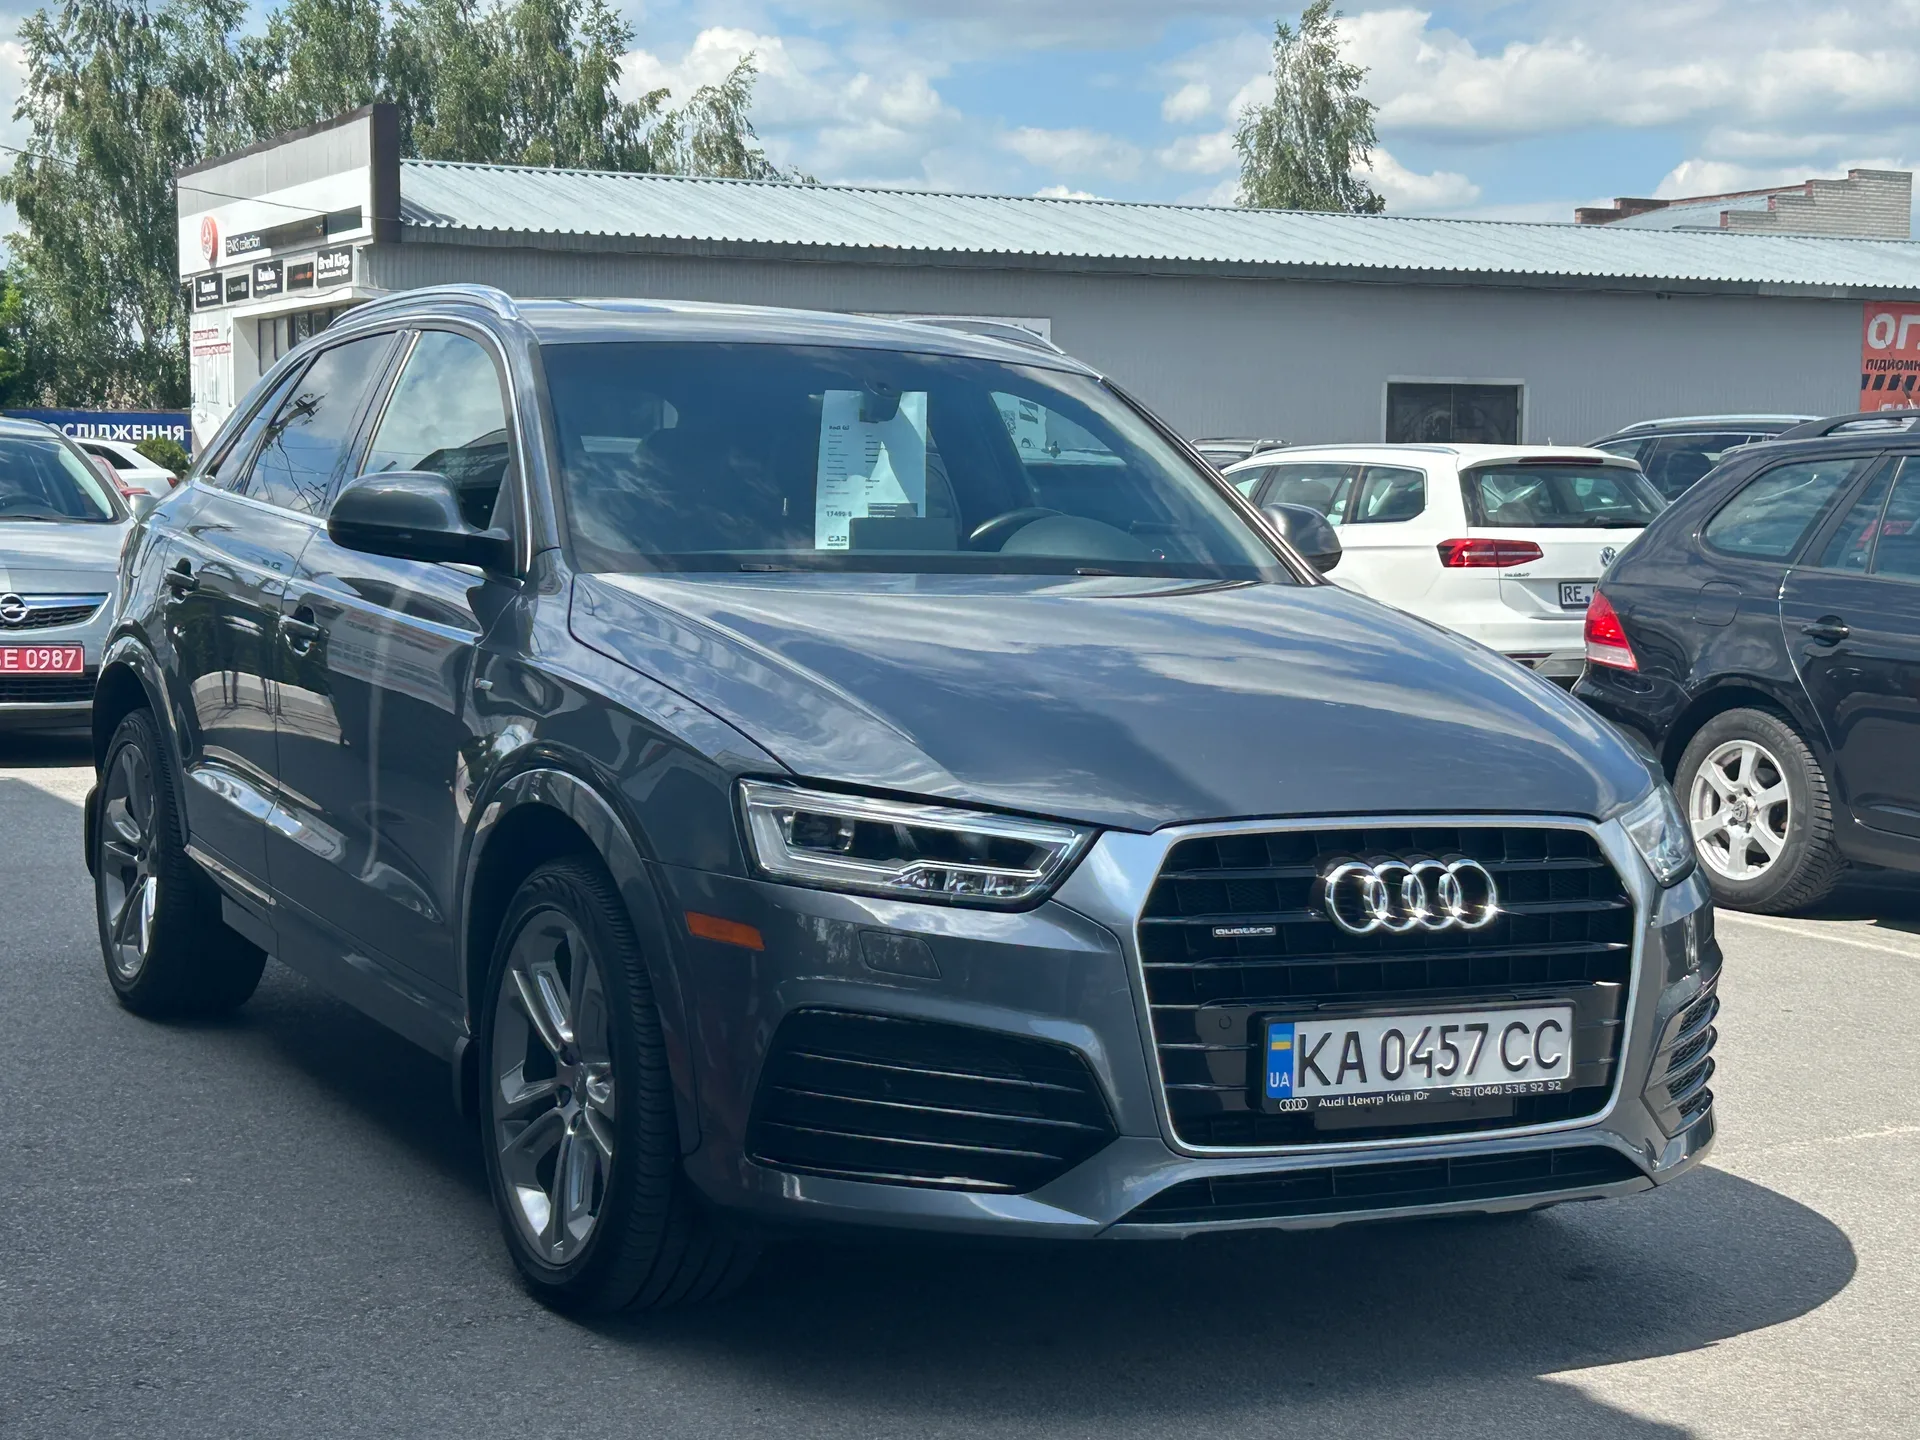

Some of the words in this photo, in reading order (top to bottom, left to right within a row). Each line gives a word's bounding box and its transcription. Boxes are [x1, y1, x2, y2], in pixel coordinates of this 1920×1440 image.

[1867, 312, 1920, 350] ОГ
[1564, 585, 1584, 603] RE
[0, 649, 19, 669] E
[26, 649, 77, 669] 0987
[1215, 926, 1274, 935] quattro
[1298, 1031, 1368, 1088] KA
[1380, 1022, 1489, 1081] 0457
[1498, 1018, 1563, 1073] CC
[1269, 1072, 1290, 1088] UA
[1450, 1087, 1472, 1097] +38
[1474, 1085, 1502, 1097] (044)
[1504, 1083, 1527, 1095] 536
[1530, 1082, 1545, 1093] 92
[1547, 1080, 1562, 1091] 92
[1318, 1097, 1345, 1108] Audi
[1347, 1094, 1384, 1106] Центр
[1386, 1092, 1411, 1102] Київ
